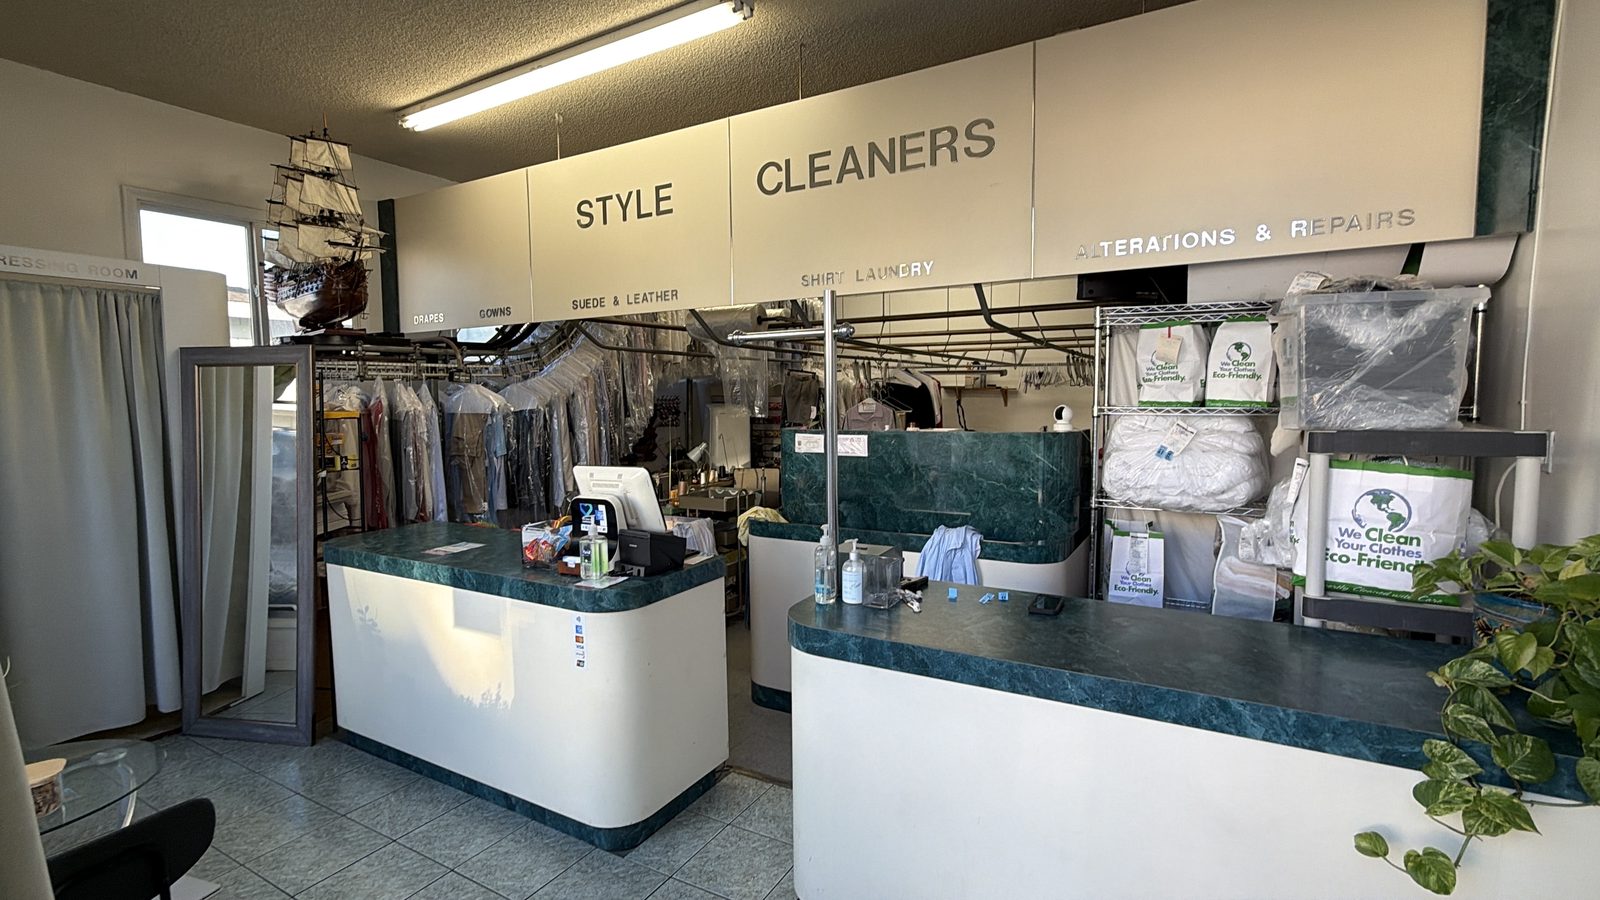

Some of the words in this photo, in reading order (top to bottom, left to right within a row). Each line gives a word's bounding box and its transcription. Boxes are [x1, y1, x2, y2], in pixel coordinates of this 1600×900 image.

[576, 183, 674, 229] STYLE
[756, 118, 996, 196] CLEANERS
[1075, 228, 1236, 260] ALTERATIONS
[1255, 224, 1272, 242] &
[1291, 208, 1416, 239] REPAIRS
[87, 264, 139, 280] ROOM
[800, 271, 845, 287] SHIRT
[855, 260, 935, 282] LAUNDRY
[571, 297, 606, 310] SUEDE
[613, 295, 620, 306] &
[626, 289, 679, 305] LEATHER
[413, 313, 445, 325] DRAPES
[479, 306, 512, 318] GOWNS
[1338, 526, 1362, 539] We
[1364, 527, 1421, 547] Clean
[1335, 538, 1366, 551] Your
[1368, 543, 1423, 559] Clothes
